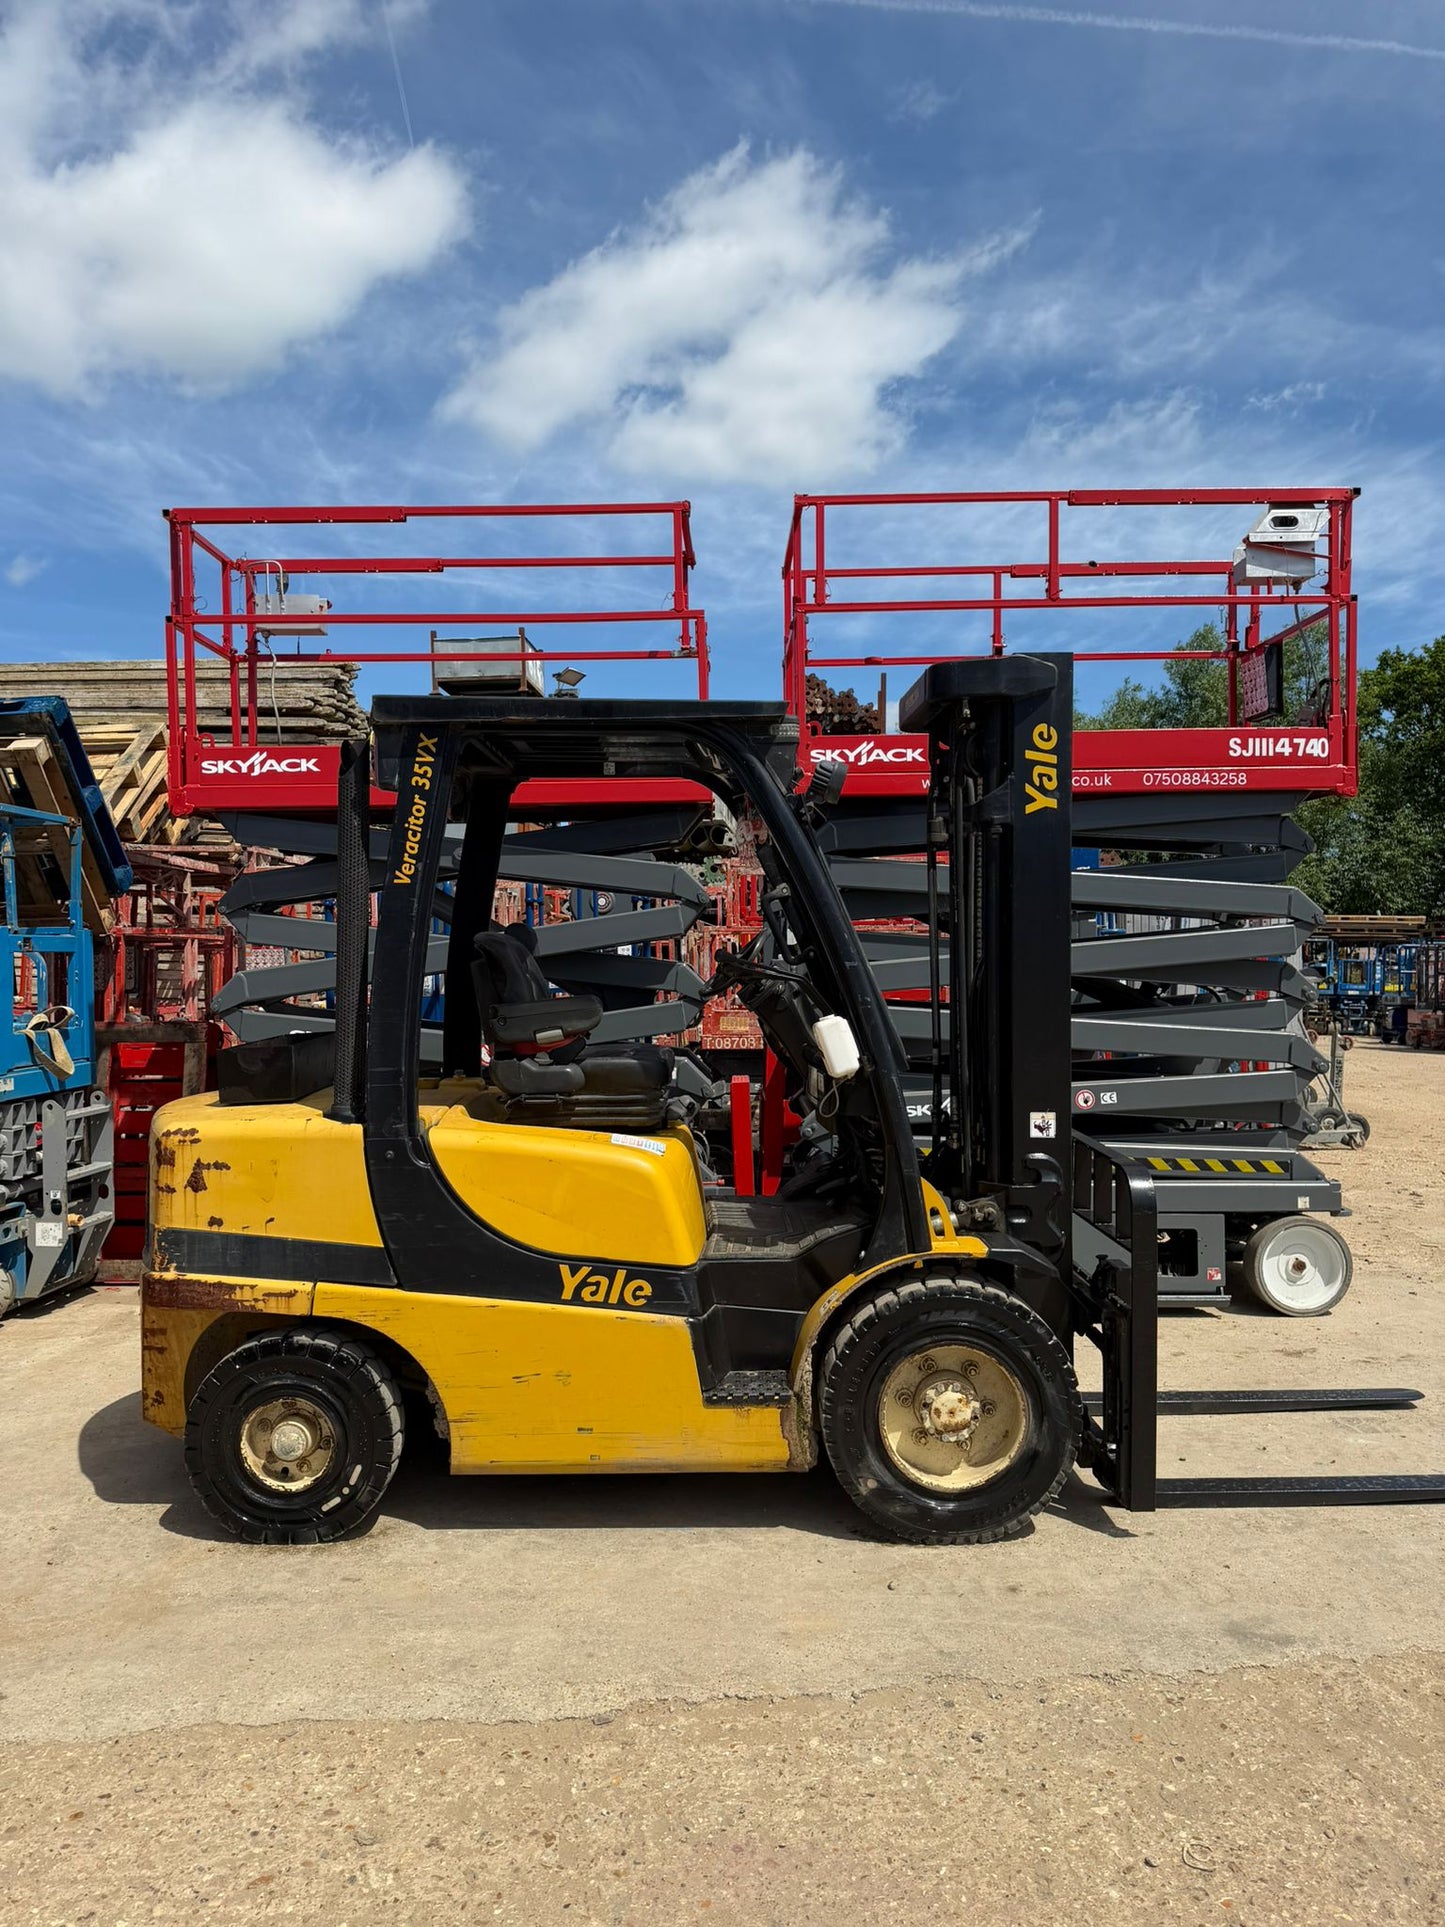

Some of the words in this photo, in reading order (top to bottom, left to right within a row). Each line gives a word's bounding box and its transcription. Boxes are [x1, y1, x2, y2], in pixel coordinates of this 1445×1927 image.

[201, 751, 321, 776] SKYJACK
[810, 741, 926, 766] SKYJACK
[1025, 723, 1058, 815] Yale
[1143, 772, 1247, 786] 07508843258
[393, 793, 427, 884] Veracitor
[410, 732, 438, 790] 35VX
[559, 1264, 653, 1307] Yale
